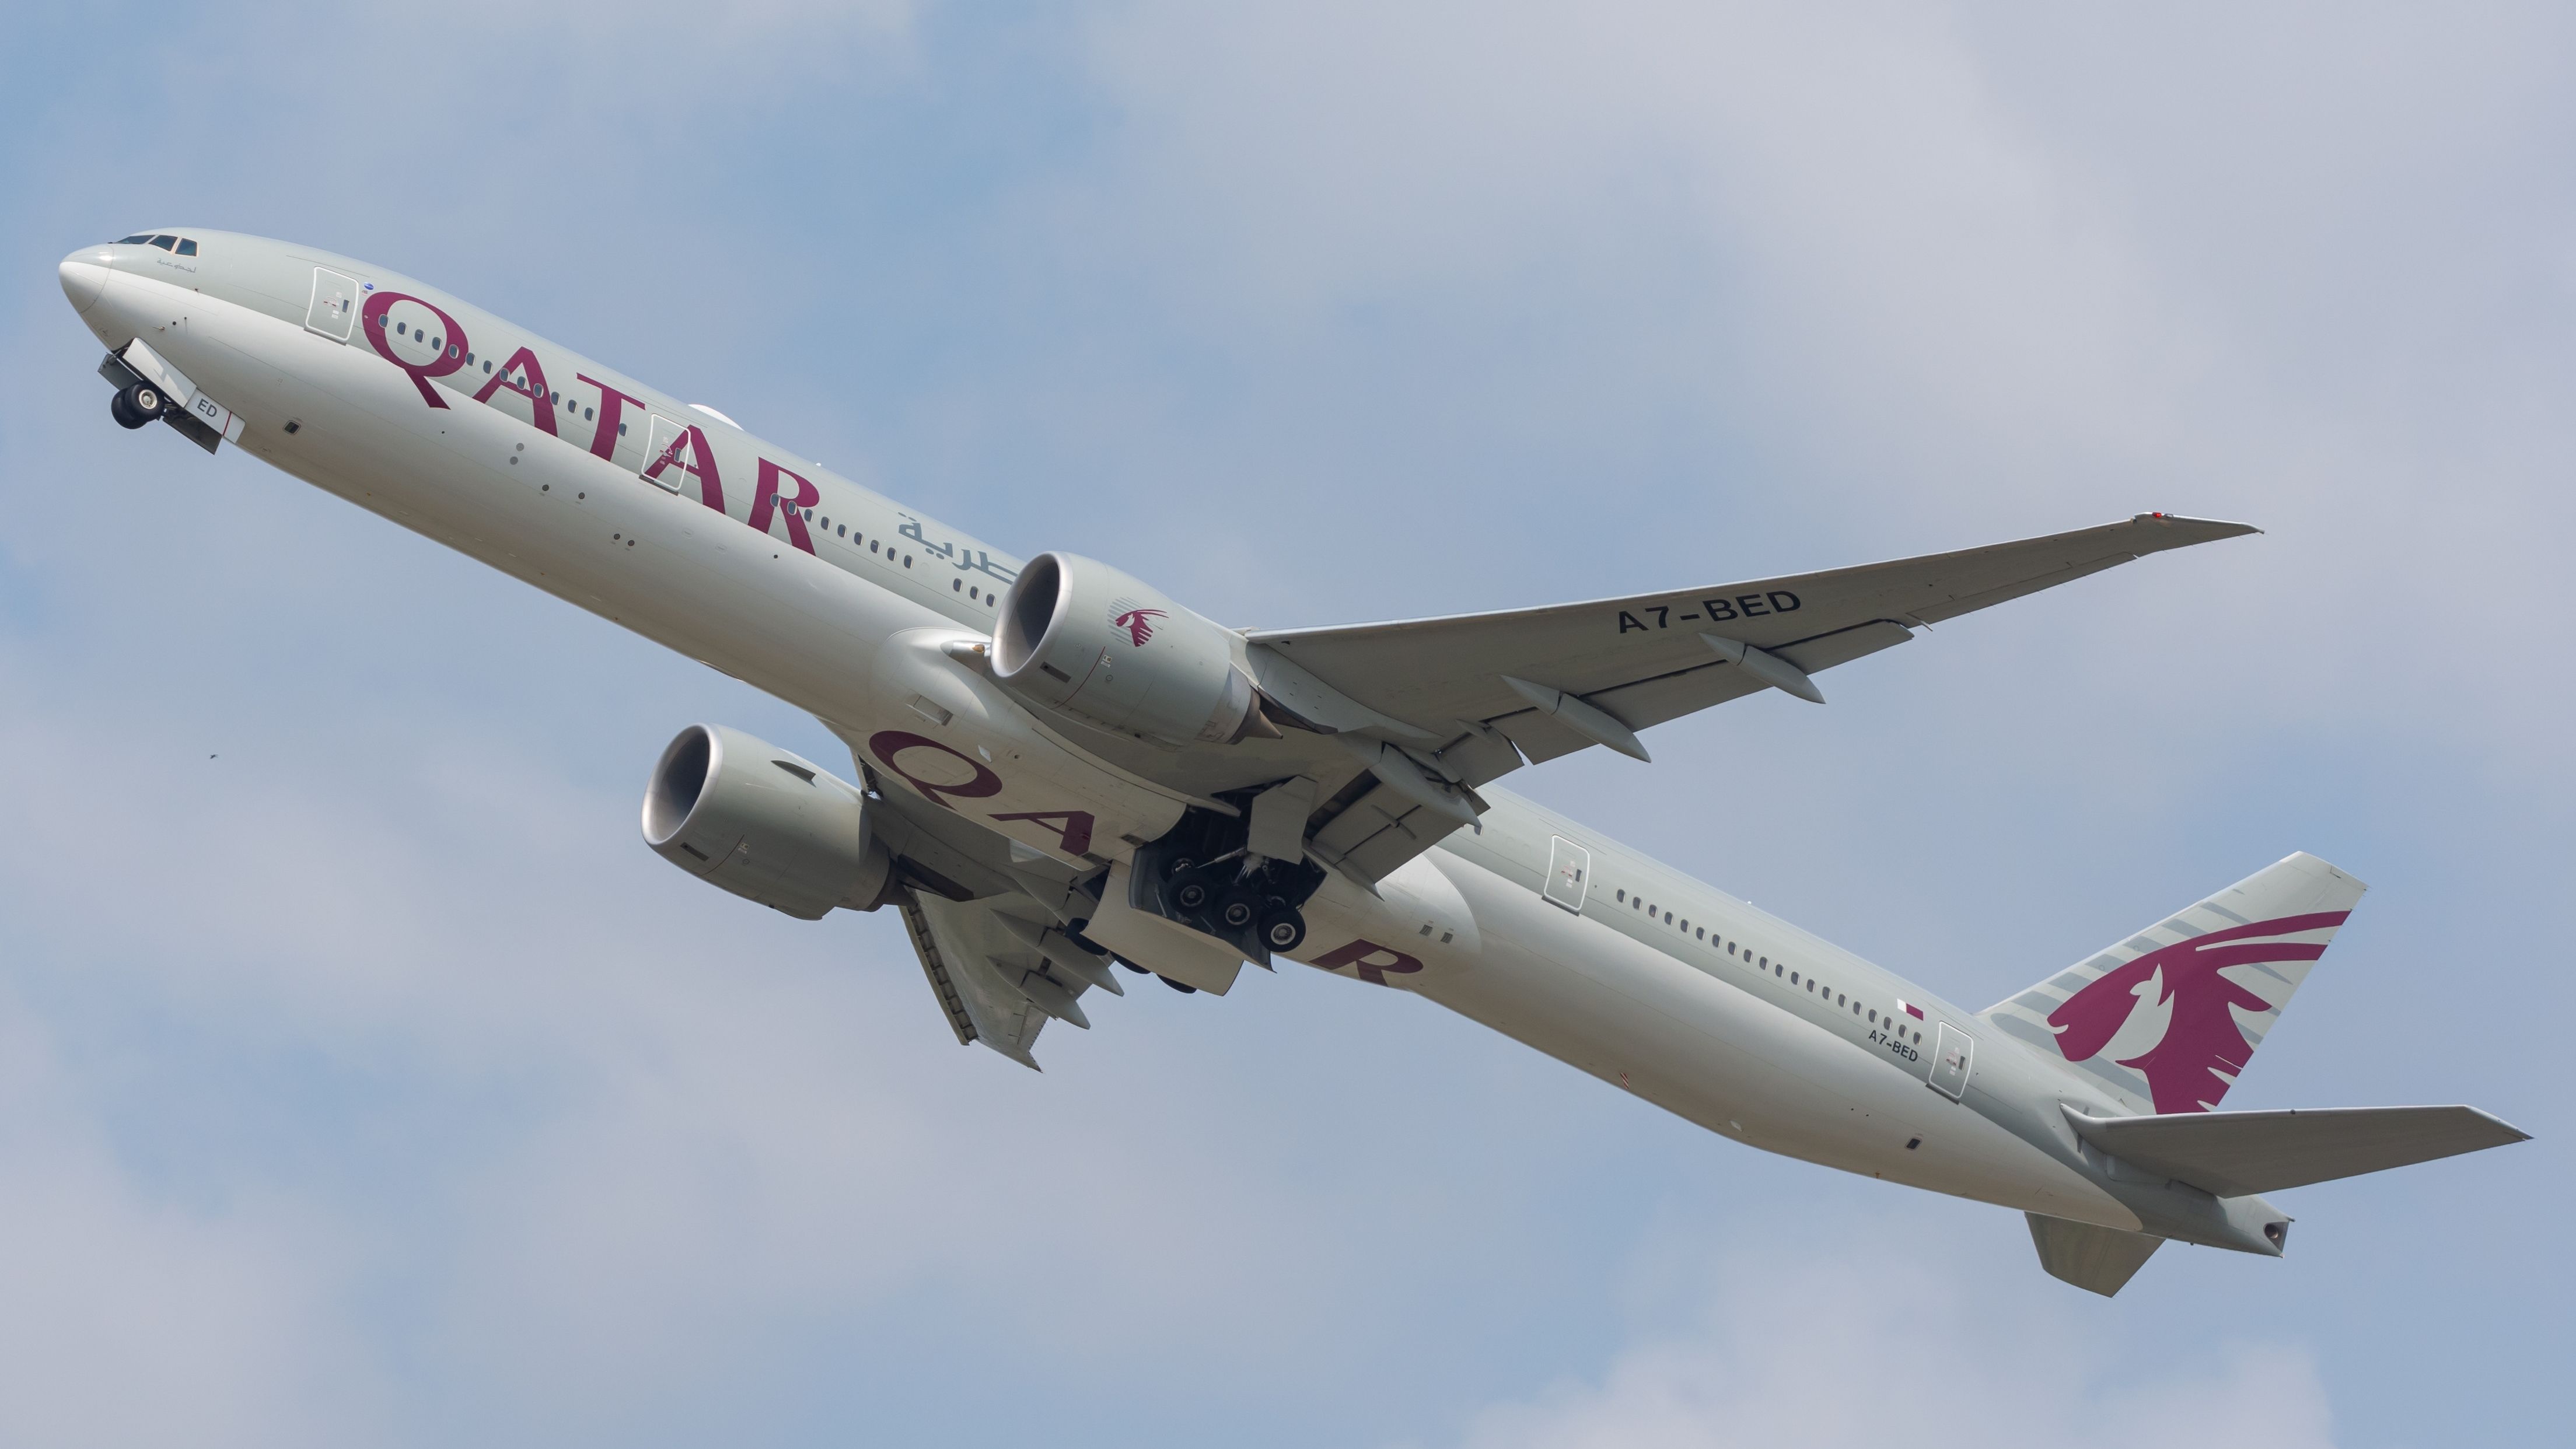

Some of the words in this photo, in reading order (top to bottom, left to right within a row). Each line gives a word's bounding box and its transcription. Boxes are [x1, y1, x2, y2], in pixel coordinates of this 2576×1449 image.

[197, 398, 217, 417] ED
[362, 291, 820, 556] QATAR
[1619, 590, 1801, 634] A7-BED
[1868, 1030, 1918, 1062] A7-BED
